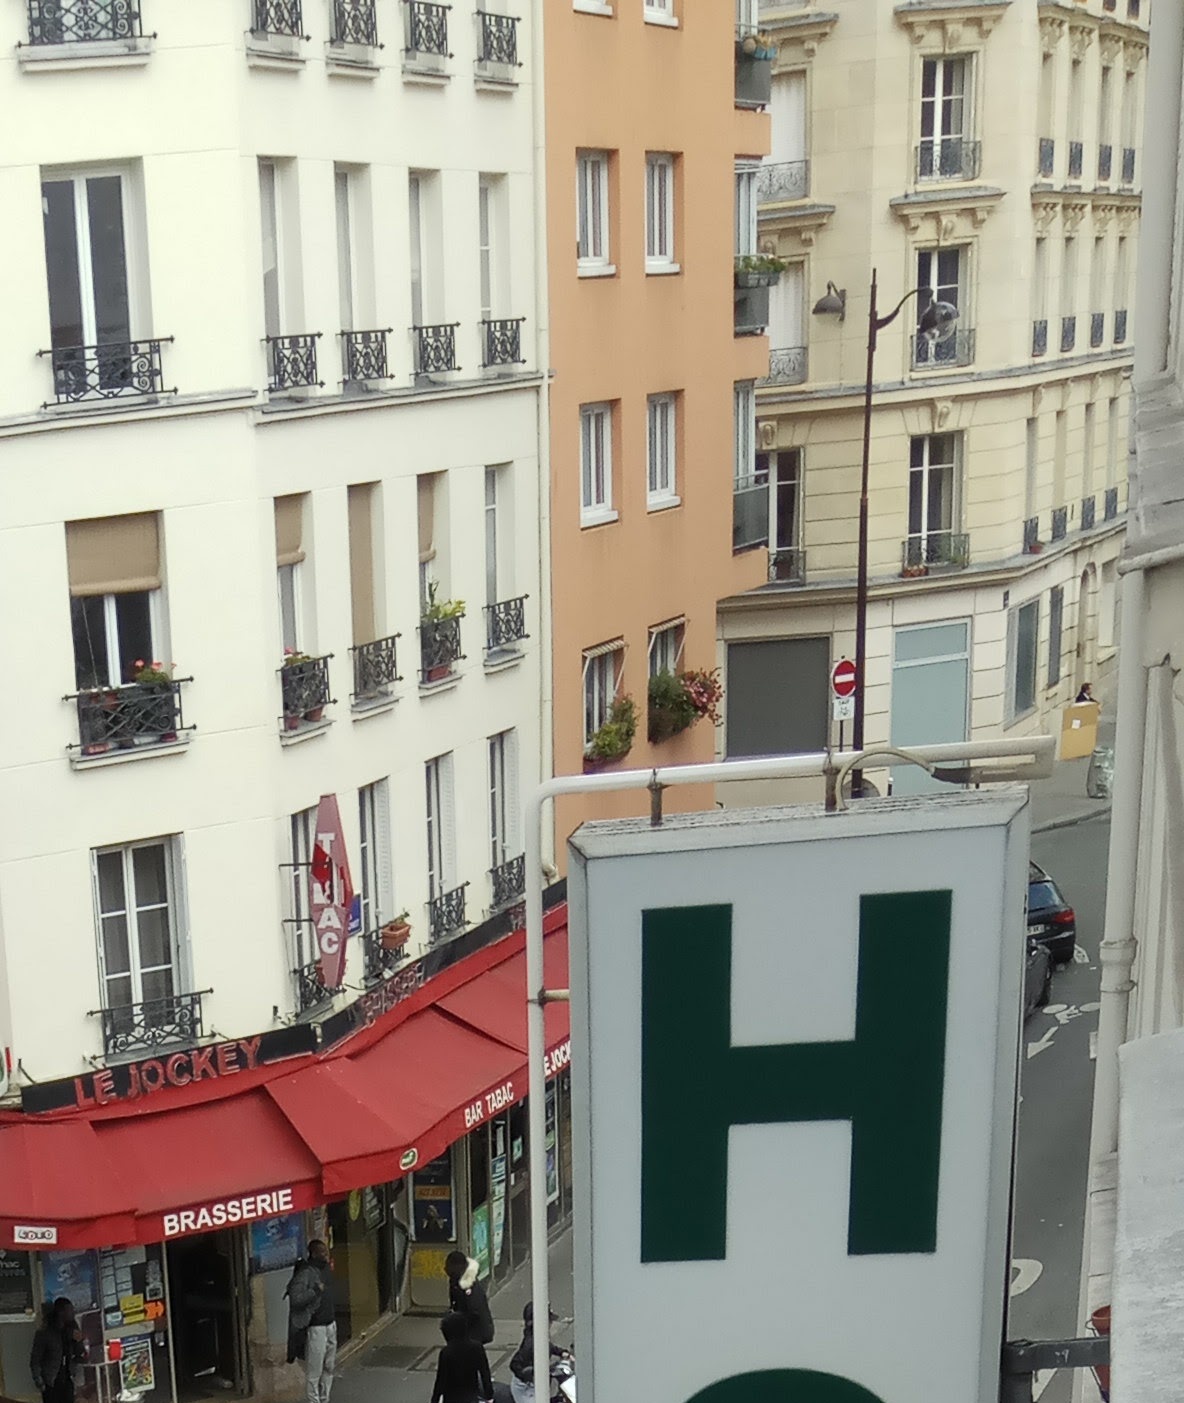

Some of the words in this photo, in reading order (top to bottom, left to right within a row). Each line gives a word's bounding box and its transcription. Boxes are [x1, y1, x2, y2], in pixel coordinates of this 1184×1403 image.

[74, 1068, 117, 1107] LE
[127, 1035, 263, 1101] JOCKEY
[551, 1040, 572, 1073] JOCK
[464, 1100, 484, 1129] BAR
[485, 1081, 515, 1114] TABAC
[163, 1188, 294, 1236] BRASSERIE
